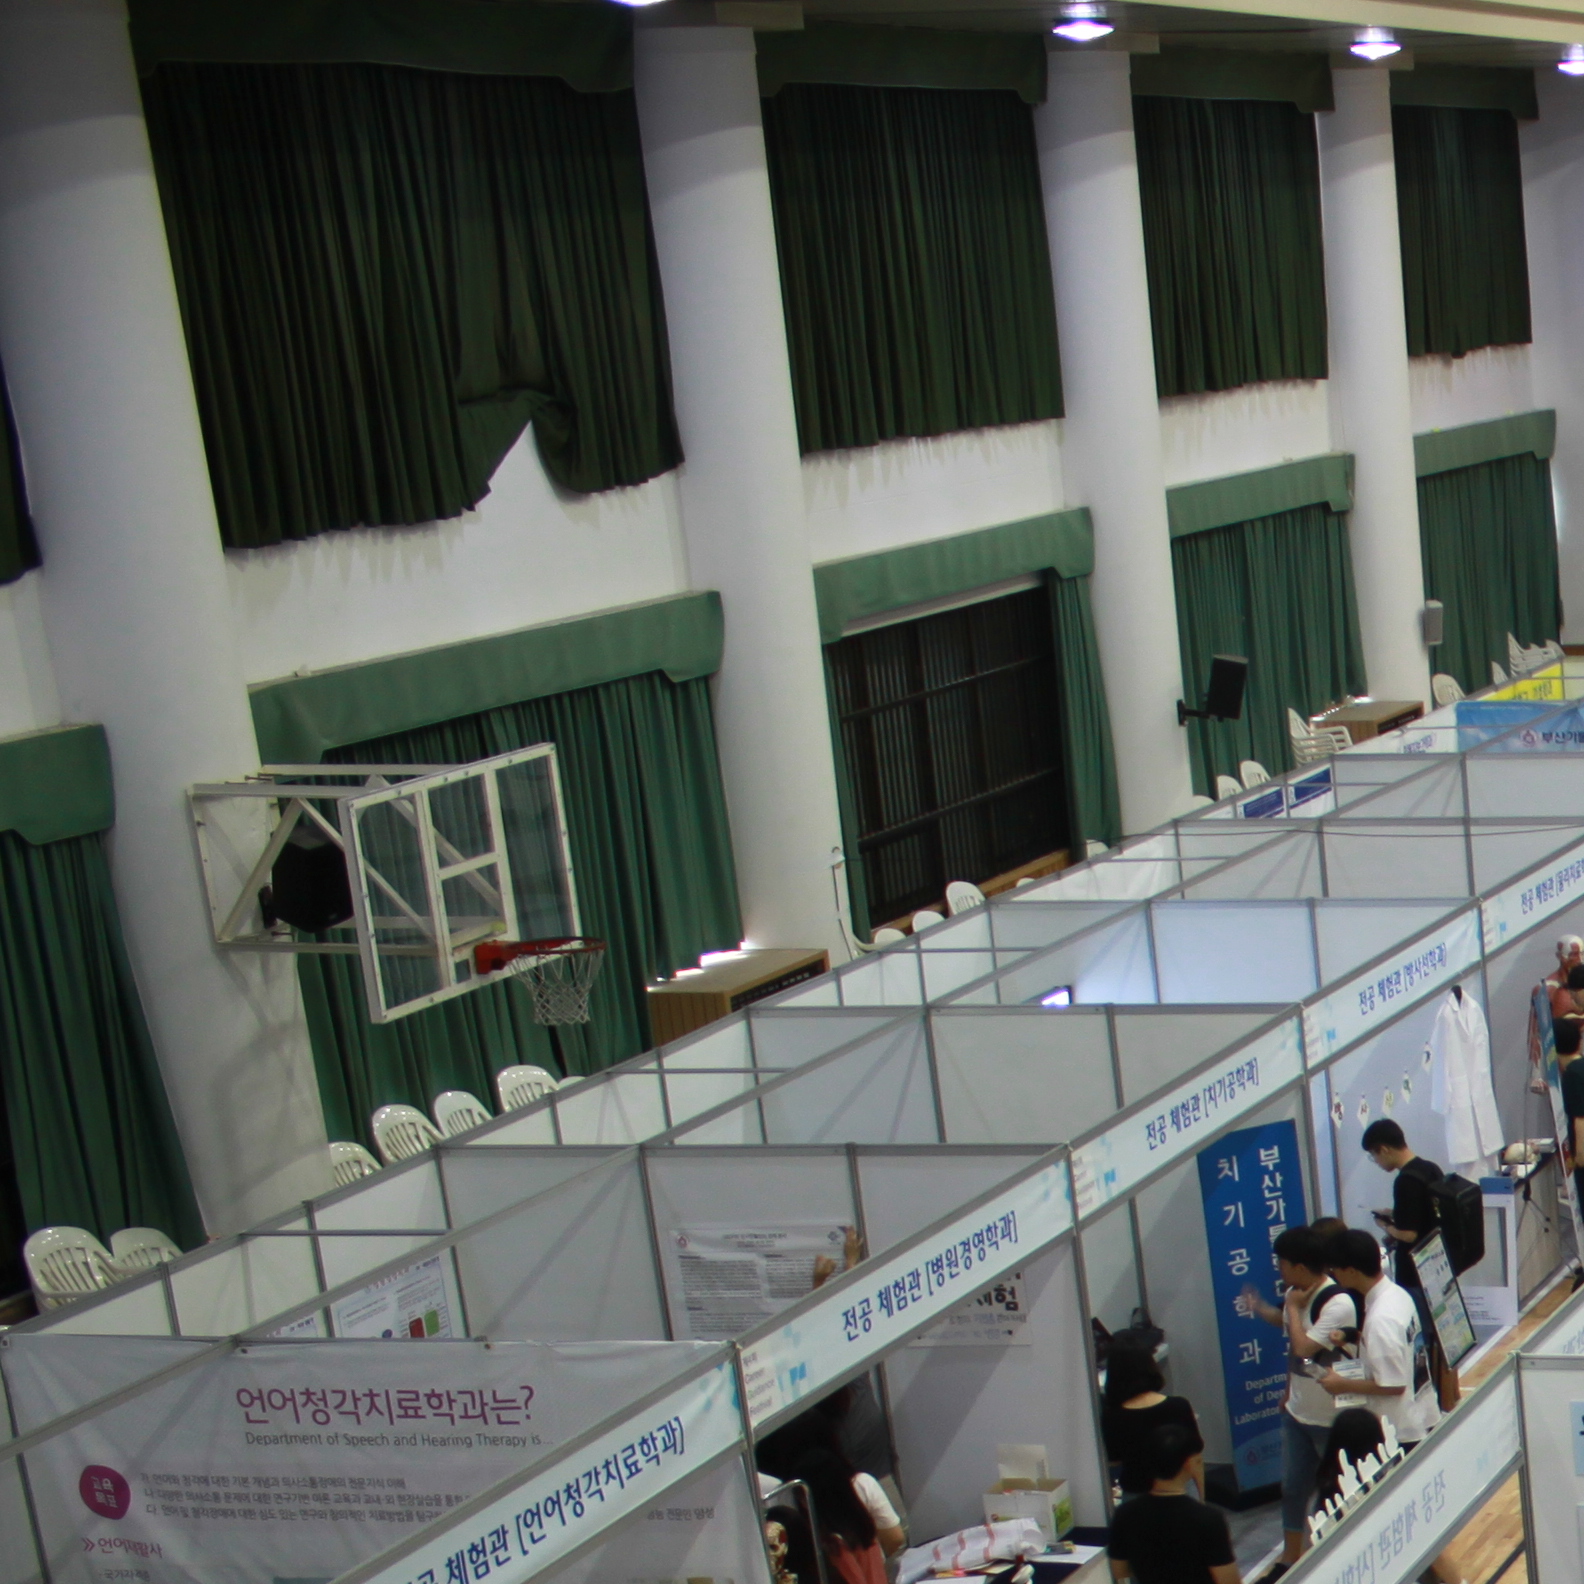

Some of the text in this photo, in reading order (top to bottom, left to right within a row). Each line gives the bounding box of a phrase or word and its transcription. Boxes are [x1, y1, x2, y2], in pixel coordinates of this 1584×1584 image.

[1358, 988, 1376, 1016] 전공
[1377, 970, 1403, 1002] 체험관
[1145, 1057, 1260, 1151] 전공 체험관 [치기공학과]
[842, 1210, 1018, 1342] 전공 체험관 [병원경영학과]
[236, 1385, 535, 1426] 언어청각치료학과는?
[246, 1431, 528, 1449] Department of Speech and Hearing Therapy
[515, 1416, 685, 1557] [언어청각치료학과]
